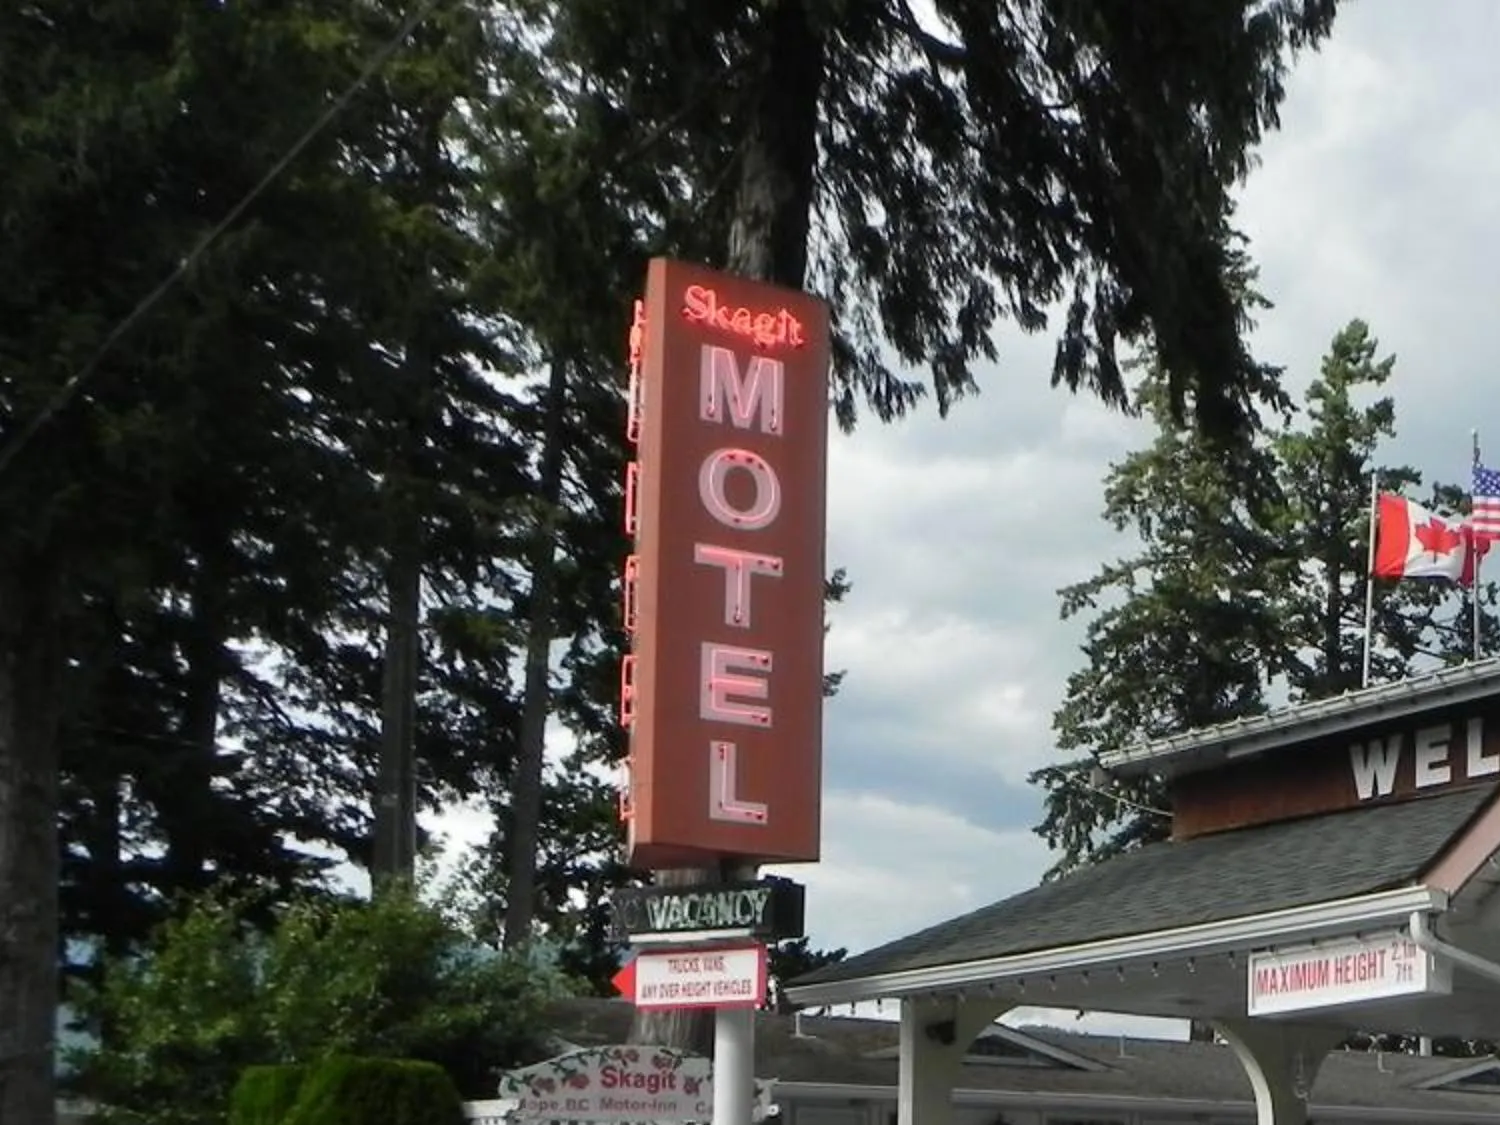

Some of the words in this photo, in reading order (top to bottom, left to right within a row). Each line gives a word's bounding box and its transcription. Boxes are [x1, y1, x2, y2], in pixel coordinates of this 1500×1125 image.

[683, 284, 805, 348] Skagit
[694, 343, 785, 825] MOTEL
[646, 889, 771, 931] VACANCY
[1256, 959, 1330, 995] MAXIMUM
[1334, 948, 1387, 985] HEIGHT
[601, 1065, 677, 1094] Skagit
